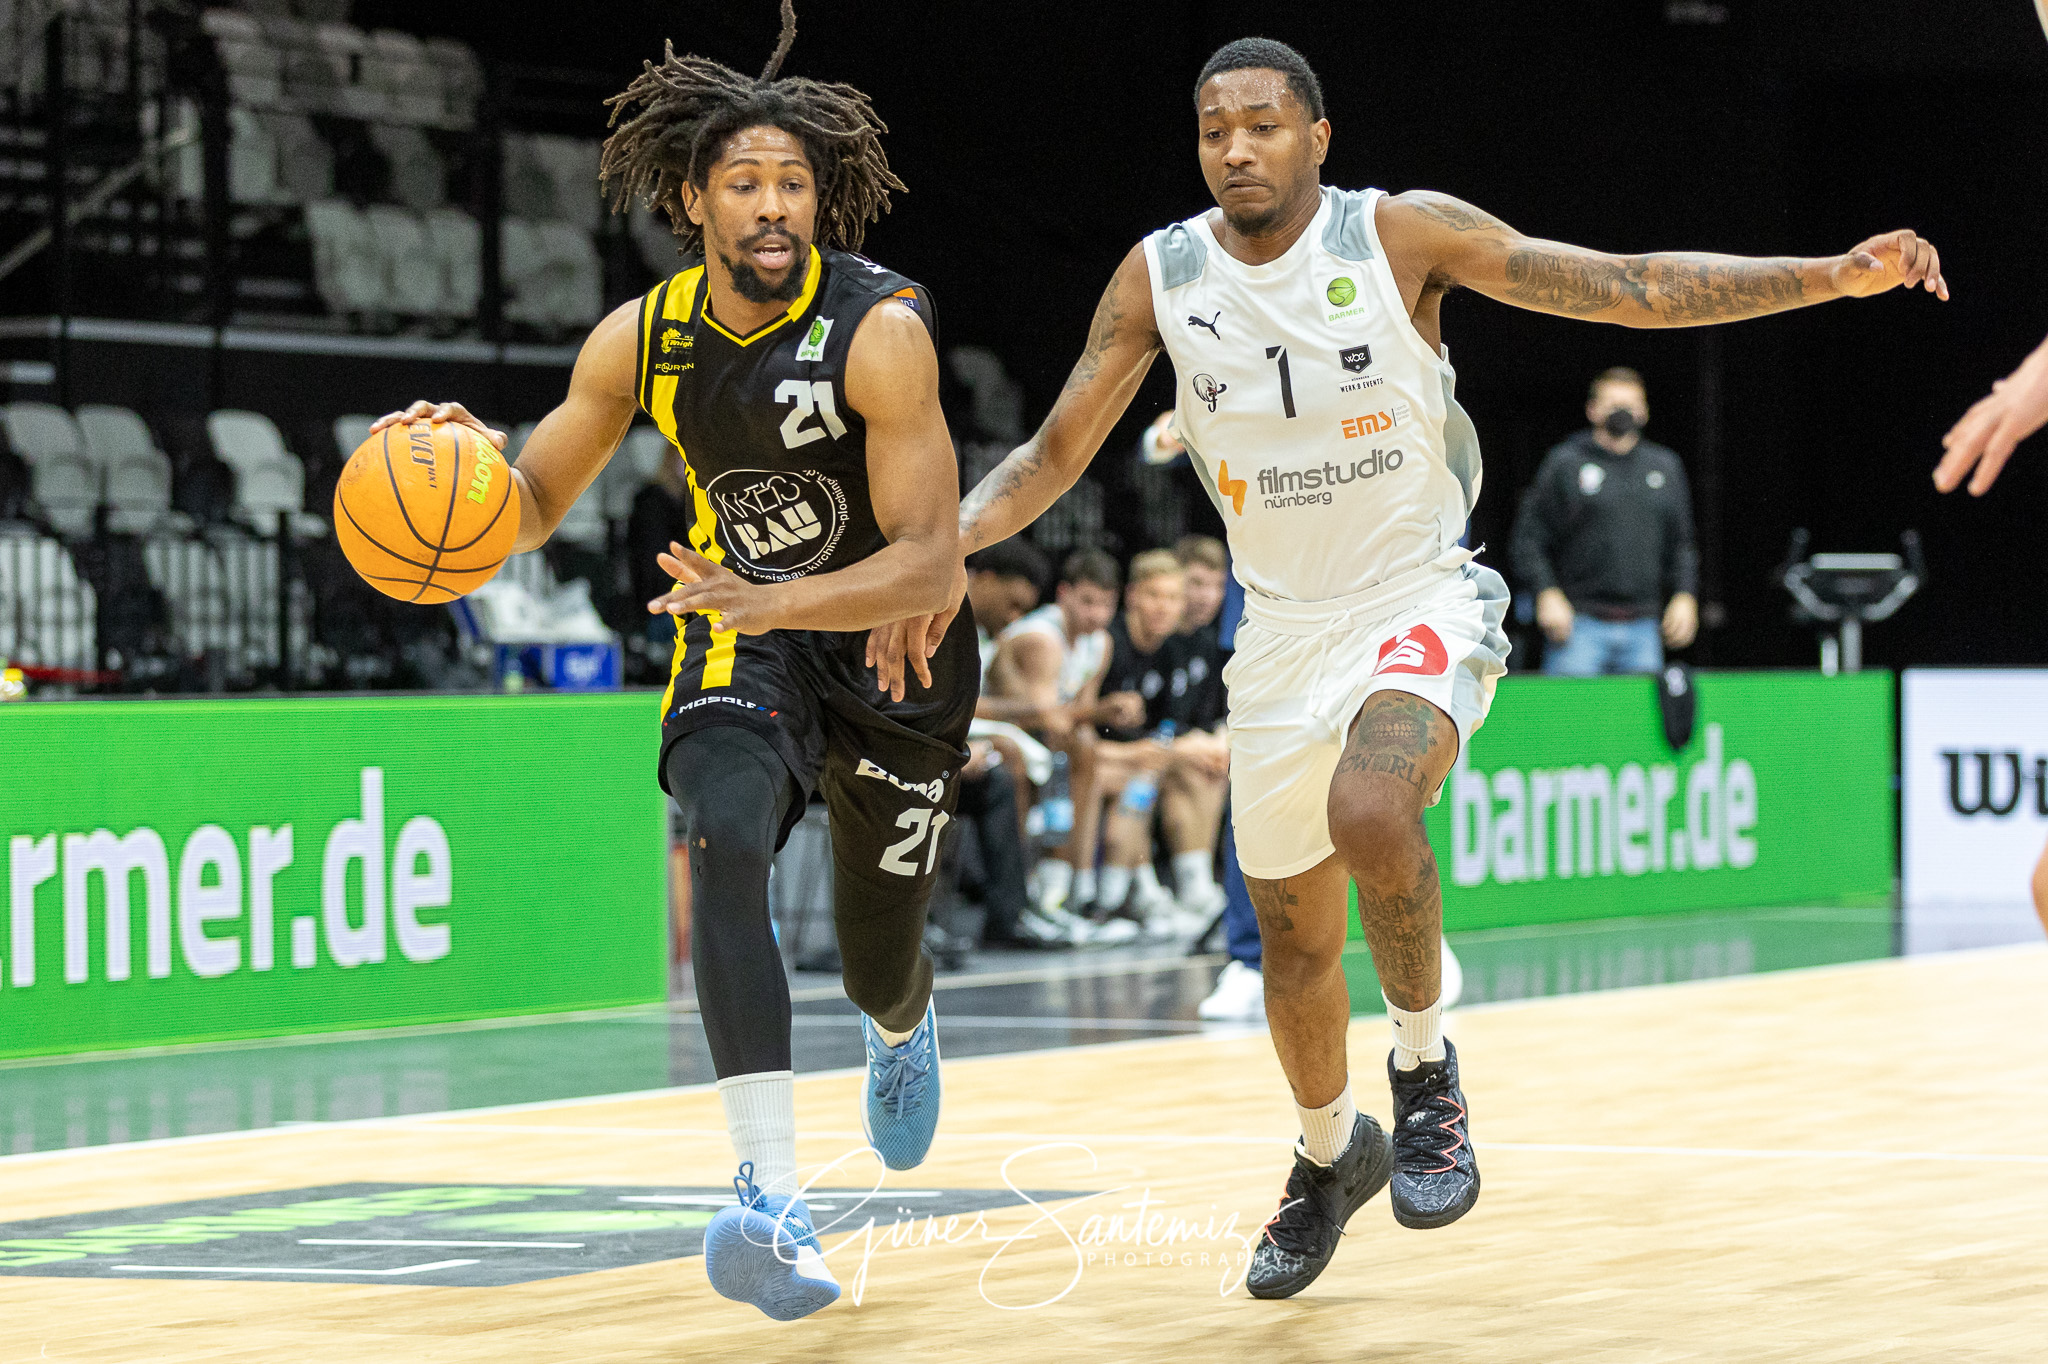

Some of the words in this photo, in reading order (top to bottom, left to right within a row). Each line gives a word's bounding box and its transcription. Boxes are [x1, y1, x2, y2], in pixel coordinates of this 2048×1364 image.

[1328, 307, 1365, 322] BARMER
[1265, 345, 1297, 419] 1
[1362, 377, 1384, 389] EVENTS
[774, 379, 848, 450] 21
[1341, 411, 1393, 440] EMS
[1257, 449, 1404, 495] filmstudio
[1264, 491, 1333, 509] nürnberg
[733, 500, 822, 560] BAU
[1451, 722, 1758, 887] barmer.de
[878, 808, 950, 876] 21
[0, 767, 453, 988] rmer.de
